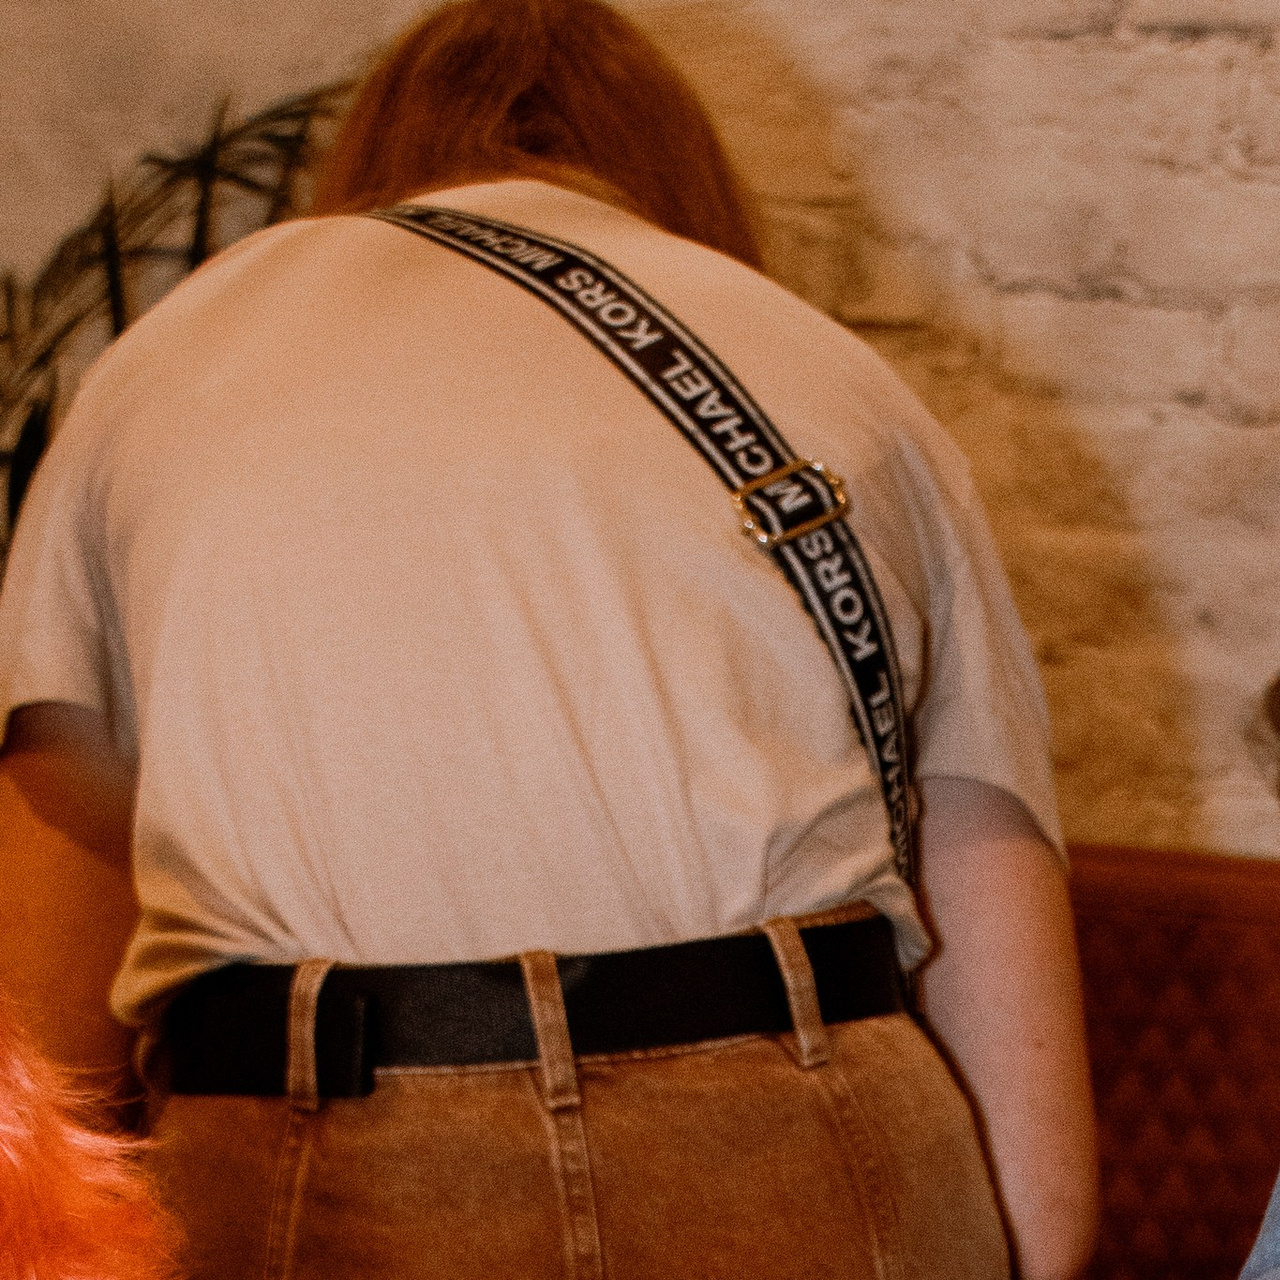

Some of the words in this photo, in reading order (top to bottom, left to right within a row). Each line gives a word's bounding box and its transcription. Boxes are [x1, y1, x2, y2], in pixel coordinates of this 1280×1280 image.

[554, 267, 665, 352] KORS
[660, 348, 812, 513] MCHAEL
[798, 527, 880, 663] KORS
